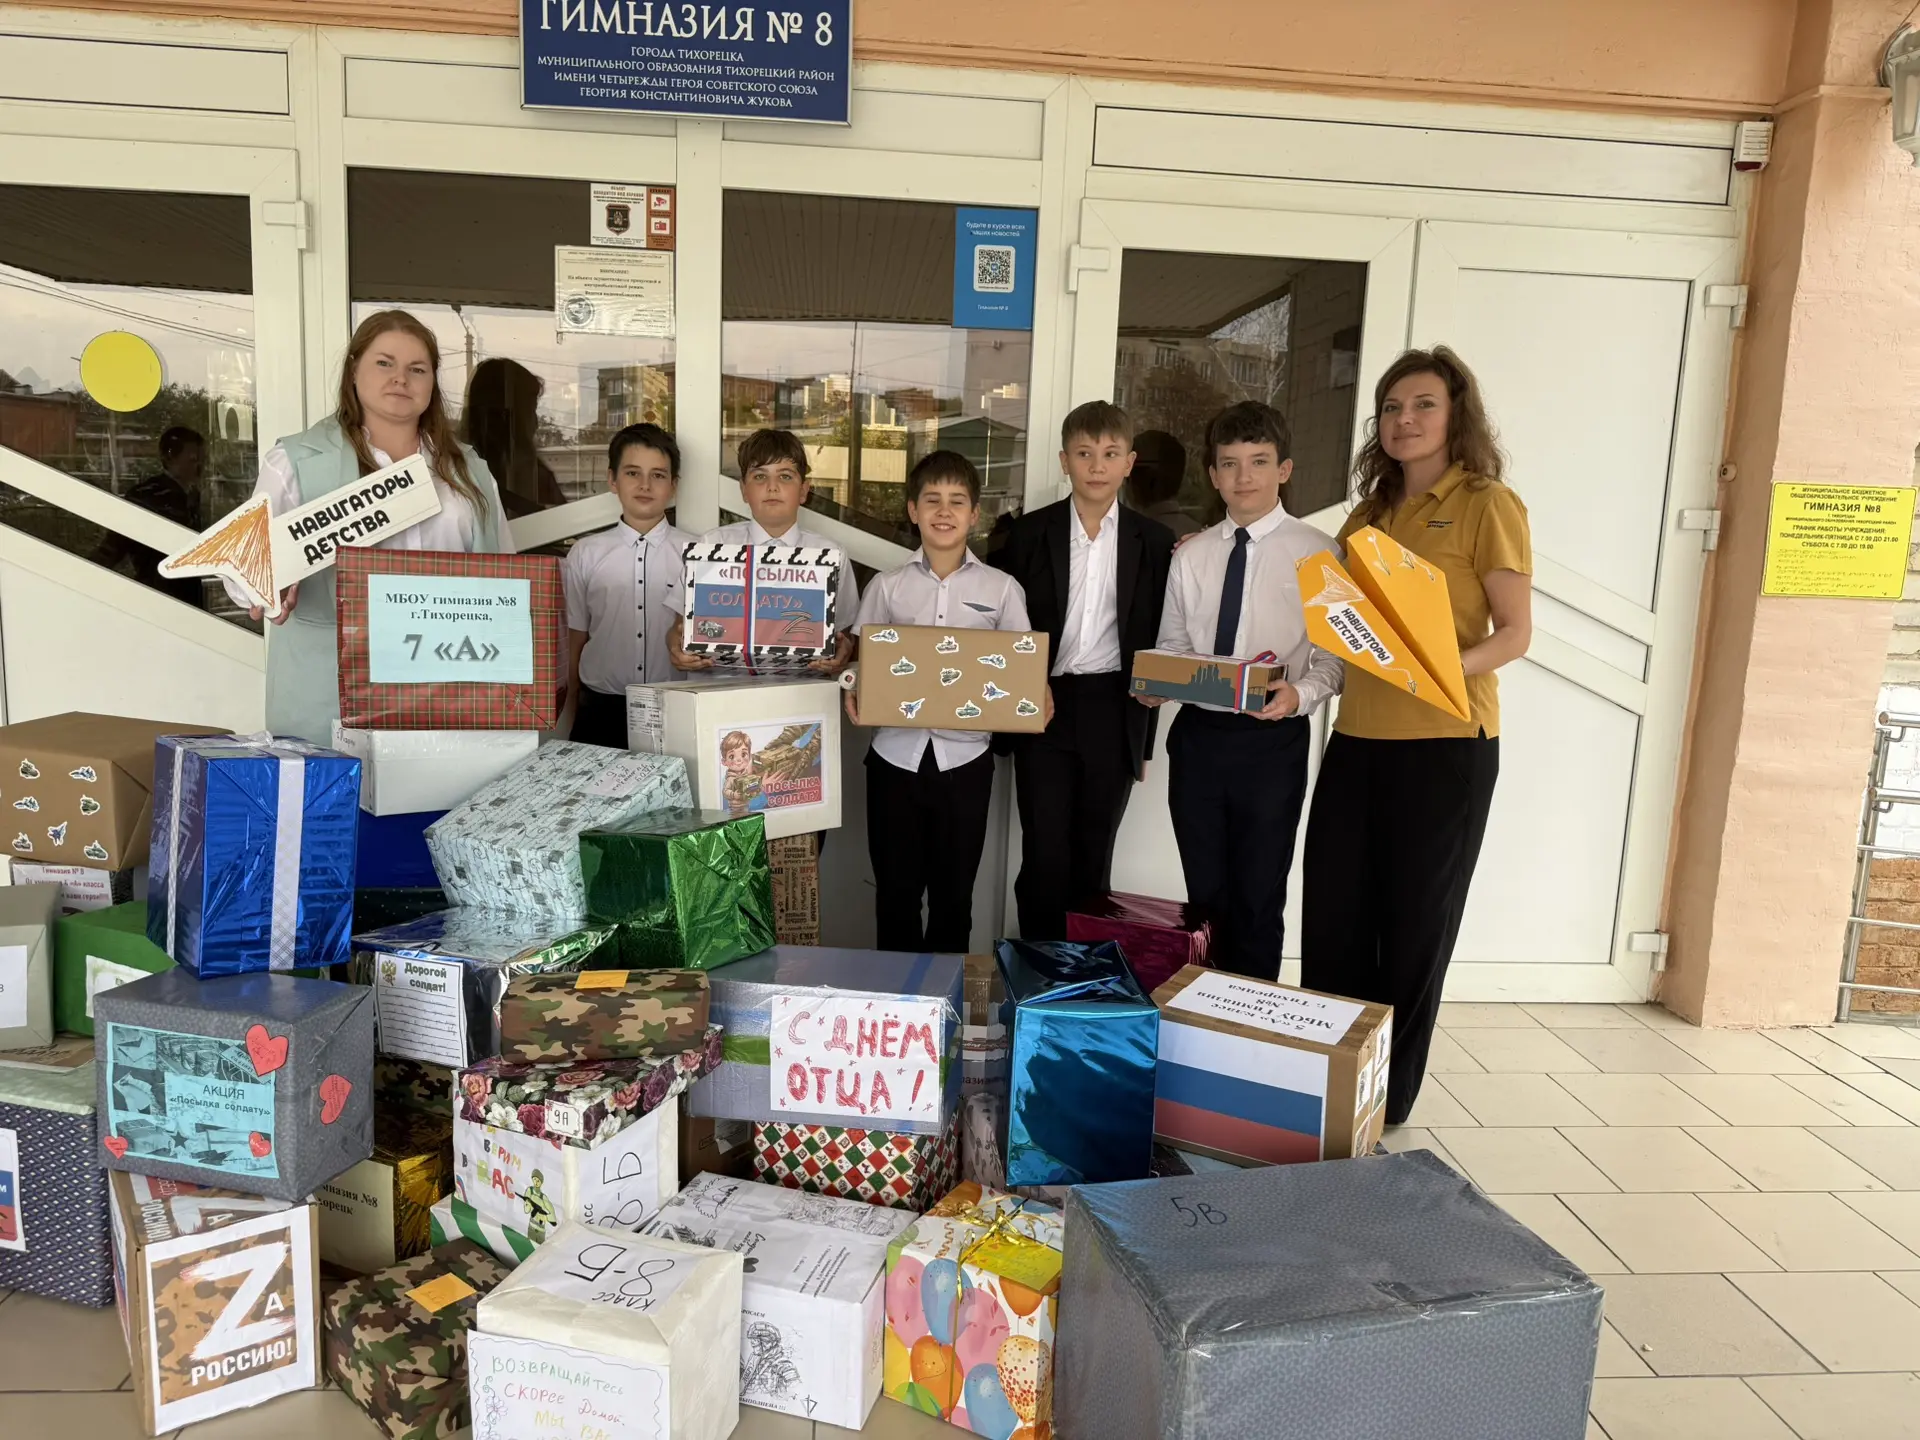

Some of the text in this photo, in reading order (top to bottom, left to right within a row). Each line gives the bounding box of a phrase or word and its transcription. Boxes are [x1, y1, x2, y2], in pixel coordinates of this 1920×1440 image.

[540, 0, 833, 46] ГИМНАЗИЯ № 8
[630, 46, 744, 62] ГОРОДА ТИХОРЕЦКА
[537, 55, 835, 81] МУНИЦИПАЛЬНОГО ОБРАЗОВАНИЯ ТИХОРЕЦКИЙ РАЙОН
[554, 71, 818, 95] ИМЕНИ ЧЕТЫРЕЖДЫ ГЕРОЯ СОВЕТСКОГО СОЮЗА
[579, 87, 792, 108] ГЕОРГИЯ КОНСТАНТИНОВИЧА ЖУКОВА
[287, 469, 415, 542] НАВИГАТОРЫ
[1803, 502, 1881, 513] ГИМНАЗИЯ №8
[303, 509, 391, 566] ДЕТСТВА
[718, 566, 818, 583] «ПСЫЛКА
[386, 593, 517, 606] МБОУ гимназия №8
[708, 592, 803, 610] СОЛАТУ»
[1327, 615, 1363, 651] ДЕТСТВА
[1341, 608, 1390, 661] НАВИГАТОРЫ
[402, 634, 500, 661] 7 «А»
[765, 777, 820, 793] ПОСЫЛКА
[768, 790, 819, 807] СОЛДАТУ
[405, 962, 446, 978] Дорогой
[410, 979, 446, 992] солдат!
[1197, 991, 1334, 1030] МБОУ Гимназия
[1211, 1003, 1255, 1017] класс
[787, 1011, 939, 1065] С ДНЁМ
[202, 1084, 245, 1100] АКЦИЯ
[170, 1094, 271, 1116] «Посылка солдату»
[555, 1110, 568, 1126] 9А
[484, 1139, 521, 1171] ВЕРИМ
[361, 1193, 378, 1208] №8
[598, 1152, 643, 1228] 8-Б
[584, 1203, 595, 1225] АСС
[1171, 1196, 1228, 1228] 5В
[564, 1243, 675, 1296] 8-Б
[592, 1292, 656, 1311] КЛАСС
[190, 1337, 293, 1386] РОССИЮ!
